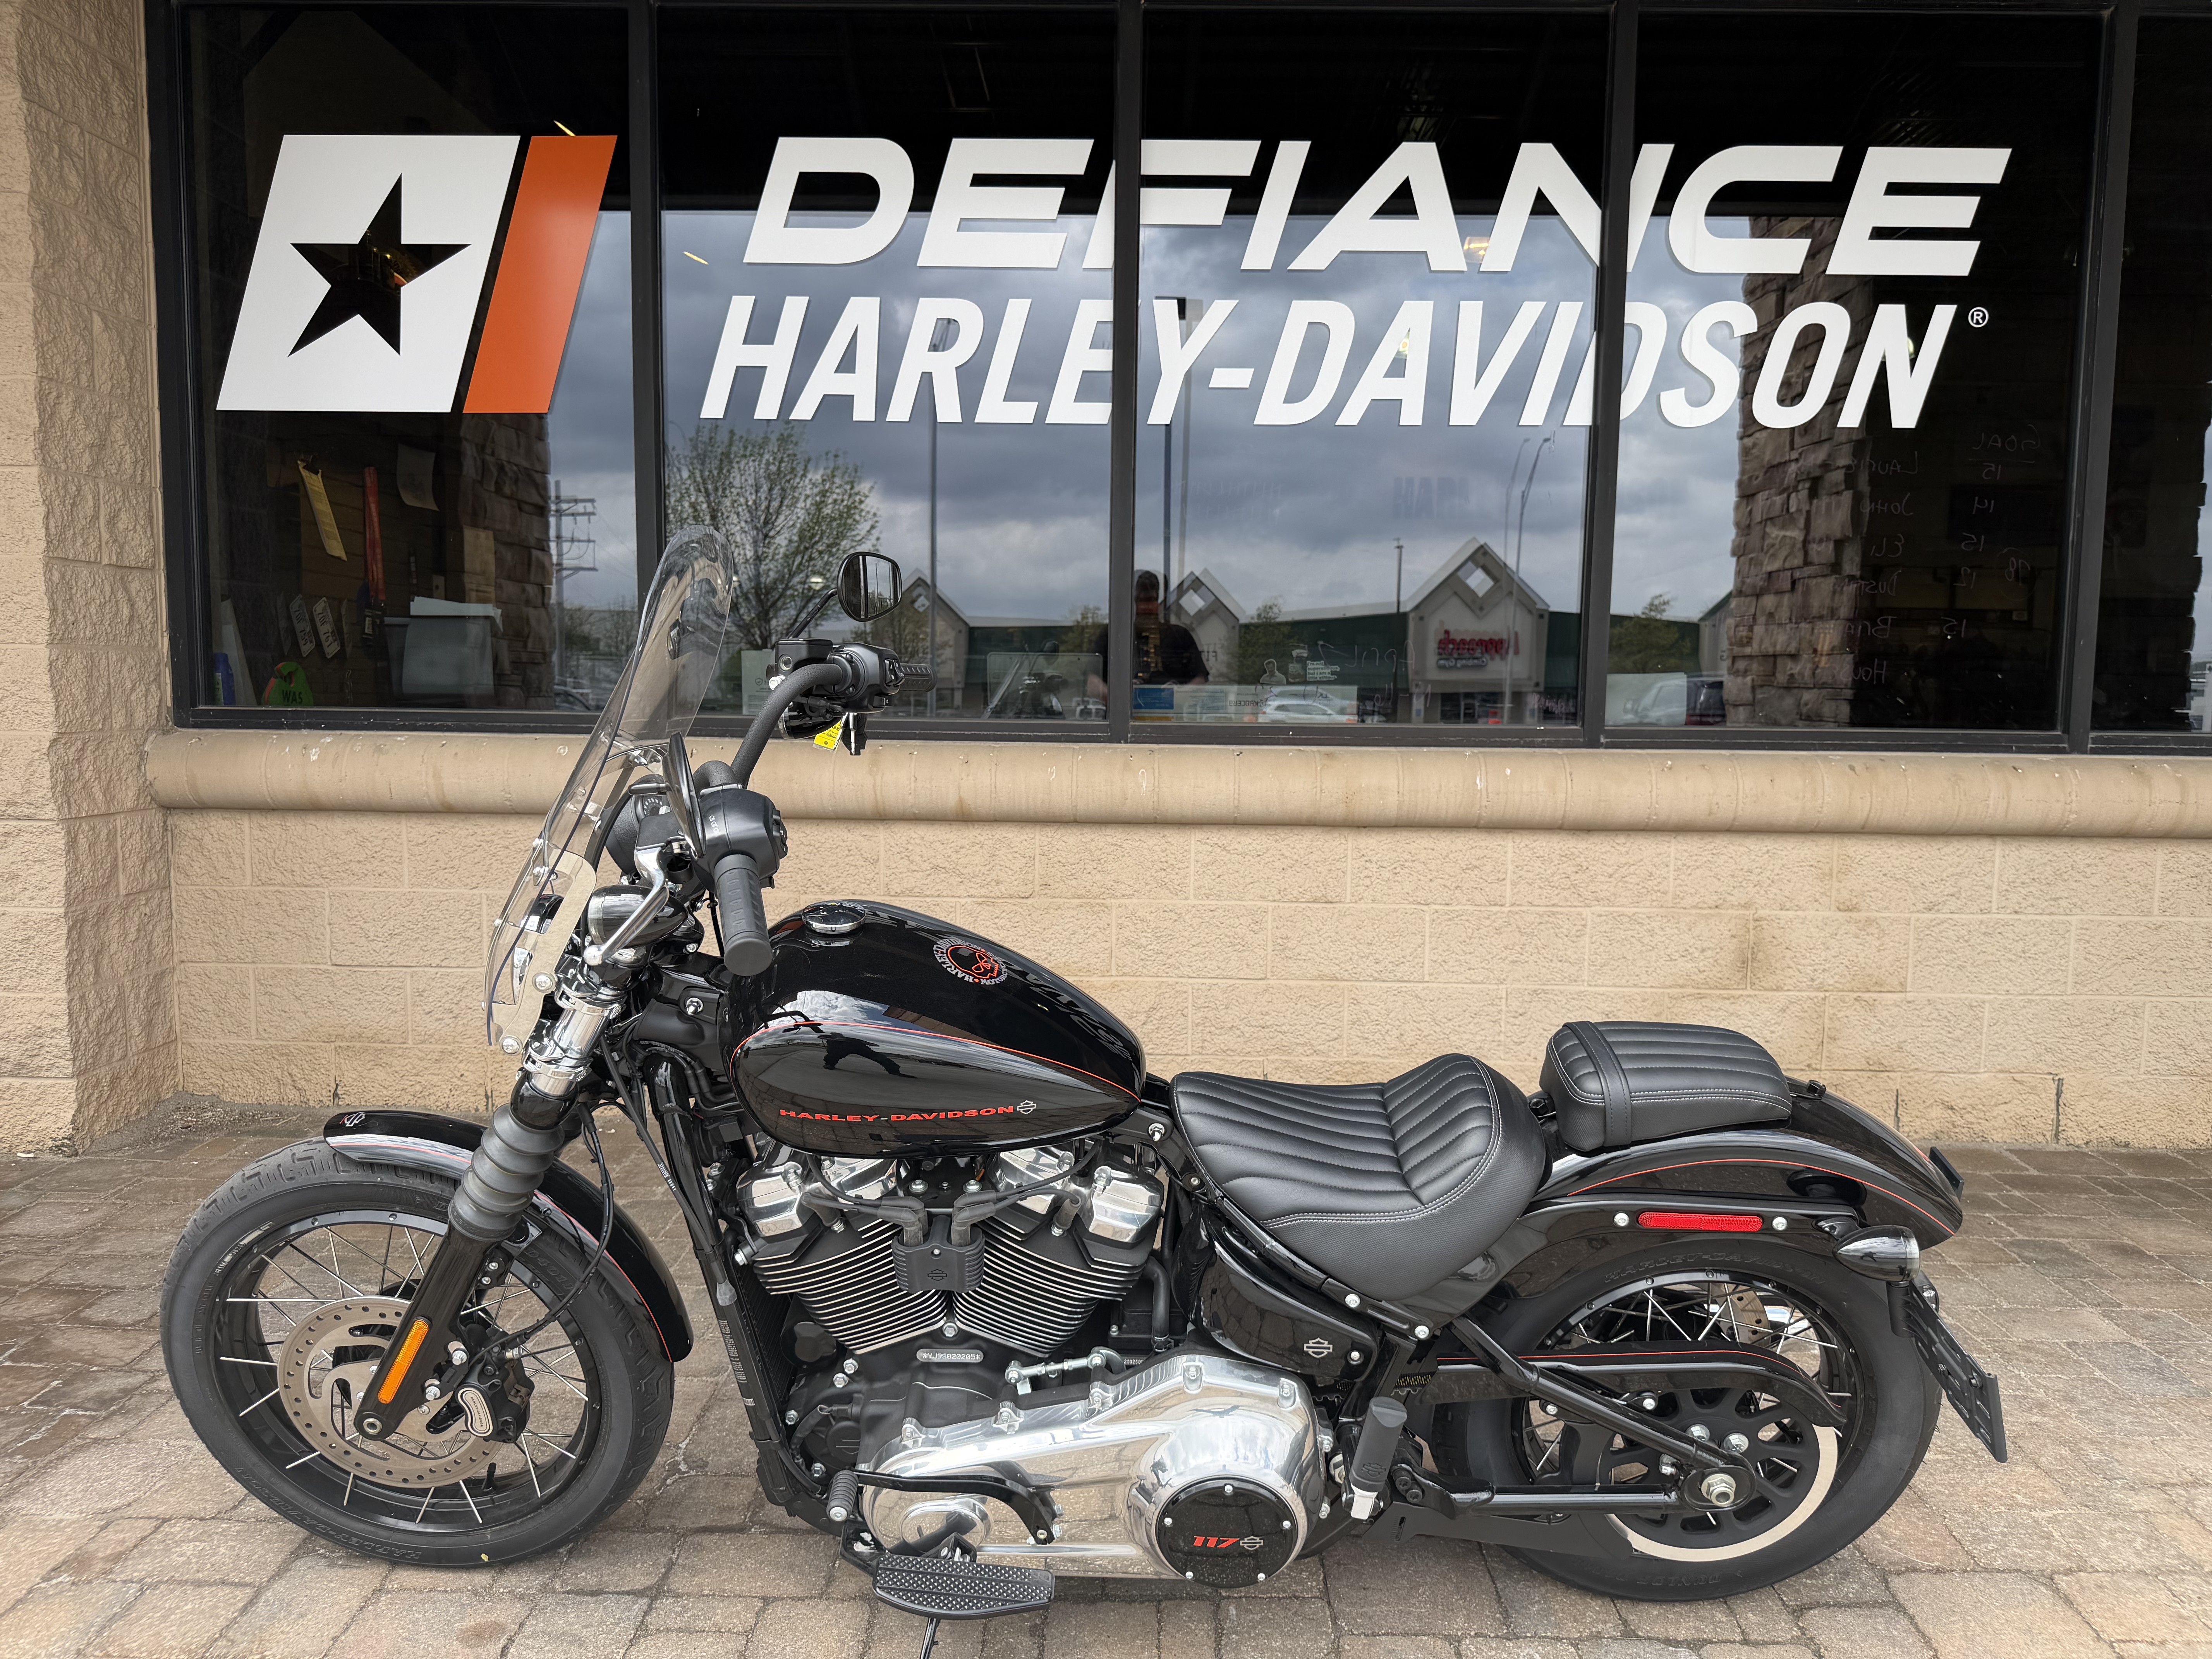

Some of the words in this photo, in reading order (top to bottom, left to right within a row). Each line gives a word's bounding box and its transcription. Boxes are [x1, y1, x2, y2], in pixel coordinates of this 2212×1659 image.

[743, 137, 2012, 276] DEFIANCE
[282, 689, 304, 704] WAS
[780, 1106, 1014, 1121] HARLEY-DAVIDSON
[1193, 1535, 1239, 1548] 117
